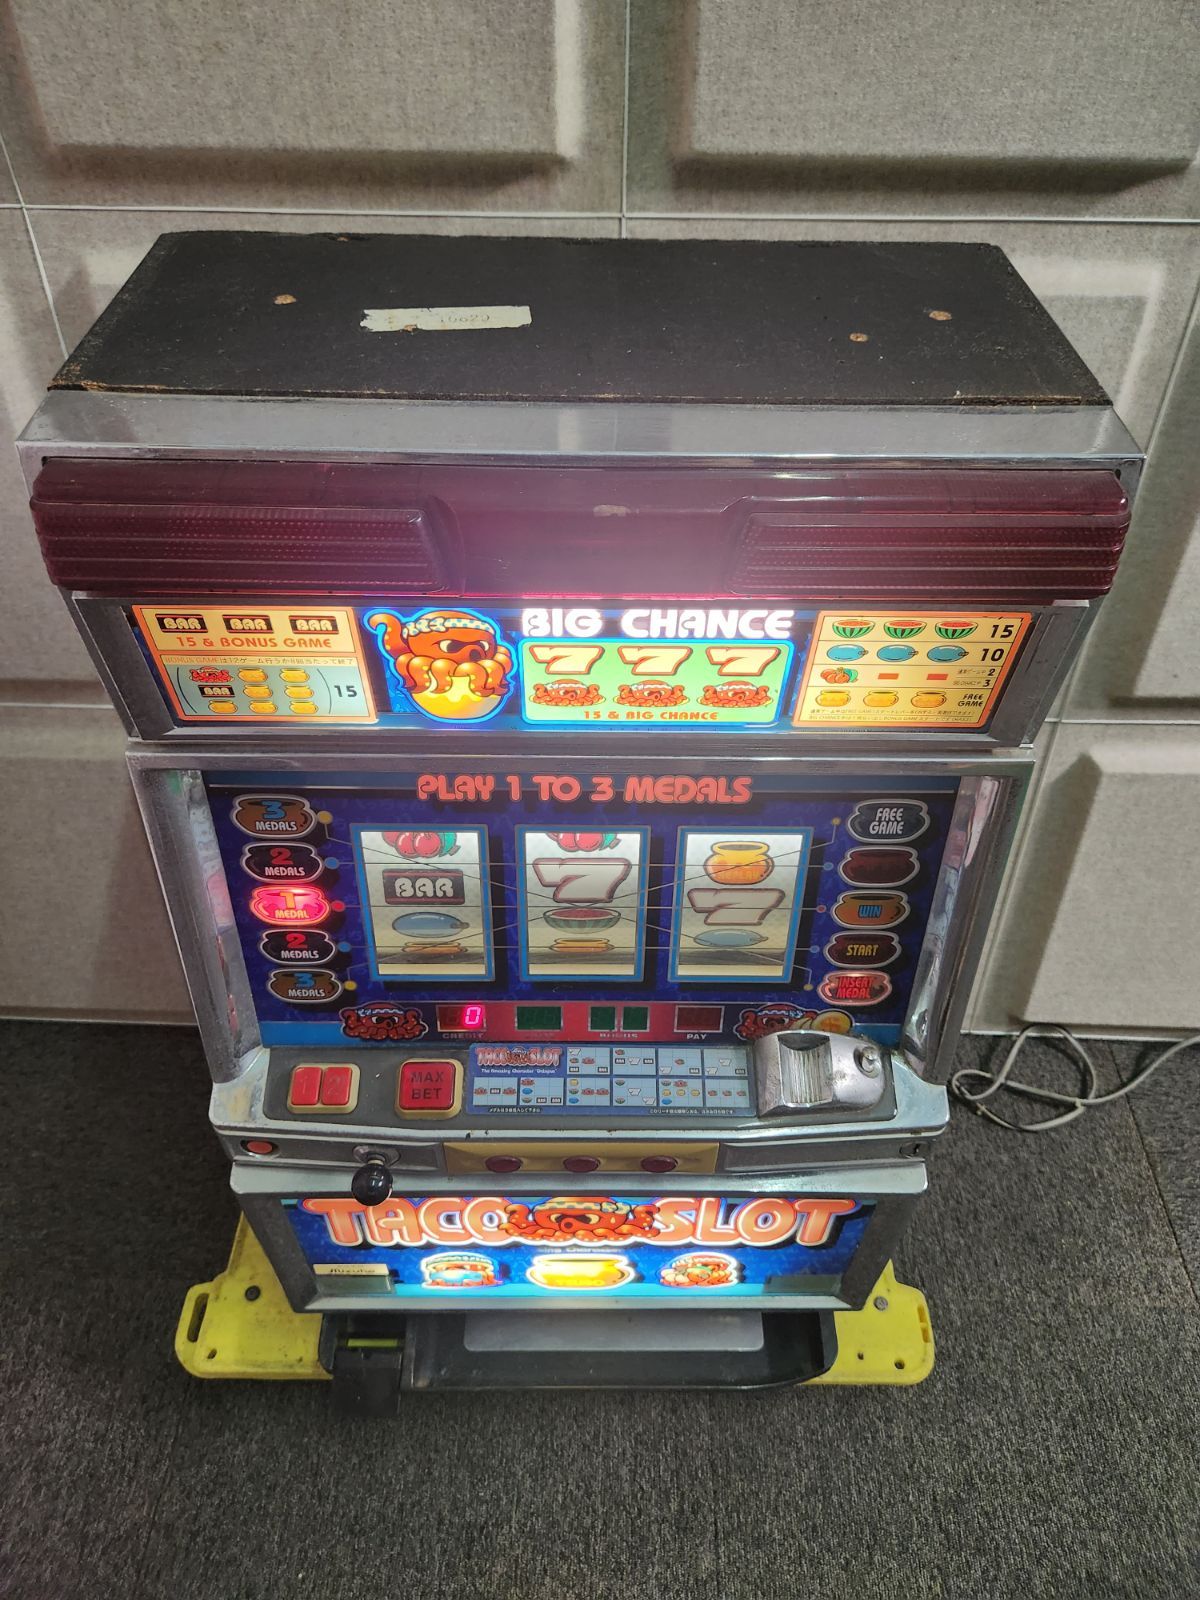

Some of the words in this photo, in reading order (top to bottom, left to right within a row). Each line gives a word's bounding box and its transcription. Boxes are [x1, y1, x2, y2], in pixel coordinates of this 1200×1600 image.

[163, 618, 201, 629] BAR
[230, 619, 268, 630] BAR
[296, 619, 333, 631] BAR
[522, 608, 603, 637] BIG
[621, 609, 795, 639] CHANCE
[991, 625, 1014, 638] 15
[176, 637, 197, 647] 15
[203, 637, 216, 647] &
[221, 637, 278, 648] BONUS
[283, 638, 332, 648] GAME
[529, 645, 604, 675] 7
[617, 646, 692, 675] 7
[706, 646, 781, 676] 7
[981, 648, 1004, 661] 10
[987, 668, 996, 677] 2
[983, 679, 991, 687] 3
[334, 685, 357, 698] 15
[584, 711, 601, 720] 15
[608, 711, 620, 720] &
[626, 711, 654, 720] BIG
[660, 711, 718, 720] CHANCE
[417, 774, 495, 801] PLAY
[506, 775, 520, 801] 1
[532, 775, 582, 802] TO
[591, 775, 614, 802] 3
[624, 775, 753, 803] MEDALS
[261, 801, 285, 819] 3
[876, 808, 904, 821] FREE
[255, 821, 297, 831] MEDALS
[869, 821, 904, 834] GAME
[270, 847, 293, 865] 2
[264, 867, 305, 876] MEDALS
[394, 877, 454, 898] BAR
[280, 892, 294, 909] 1
[275, 909, 309, 919] MEDAL
[858, 905, 882, 918] WIN
[286, 933, 308, 948] 2
[281, 950, 319, 959] MEDALS
[846, 945, 879, 956] START
[294, 973, 315, 988] 3
[838, 977, 874, 988] INSERT
[288, 989, 325, 997] MEDALS
[836, 987, 872, 998] MEDAL
[464, 1006, 481, 1025] 0
[410, 1071, 445, 1083] MAX
[411, 1087, 442, 1099] BET
[302, 1197, 512, 1246] TACO
[651, 1197, 857, 1246] SLOT
